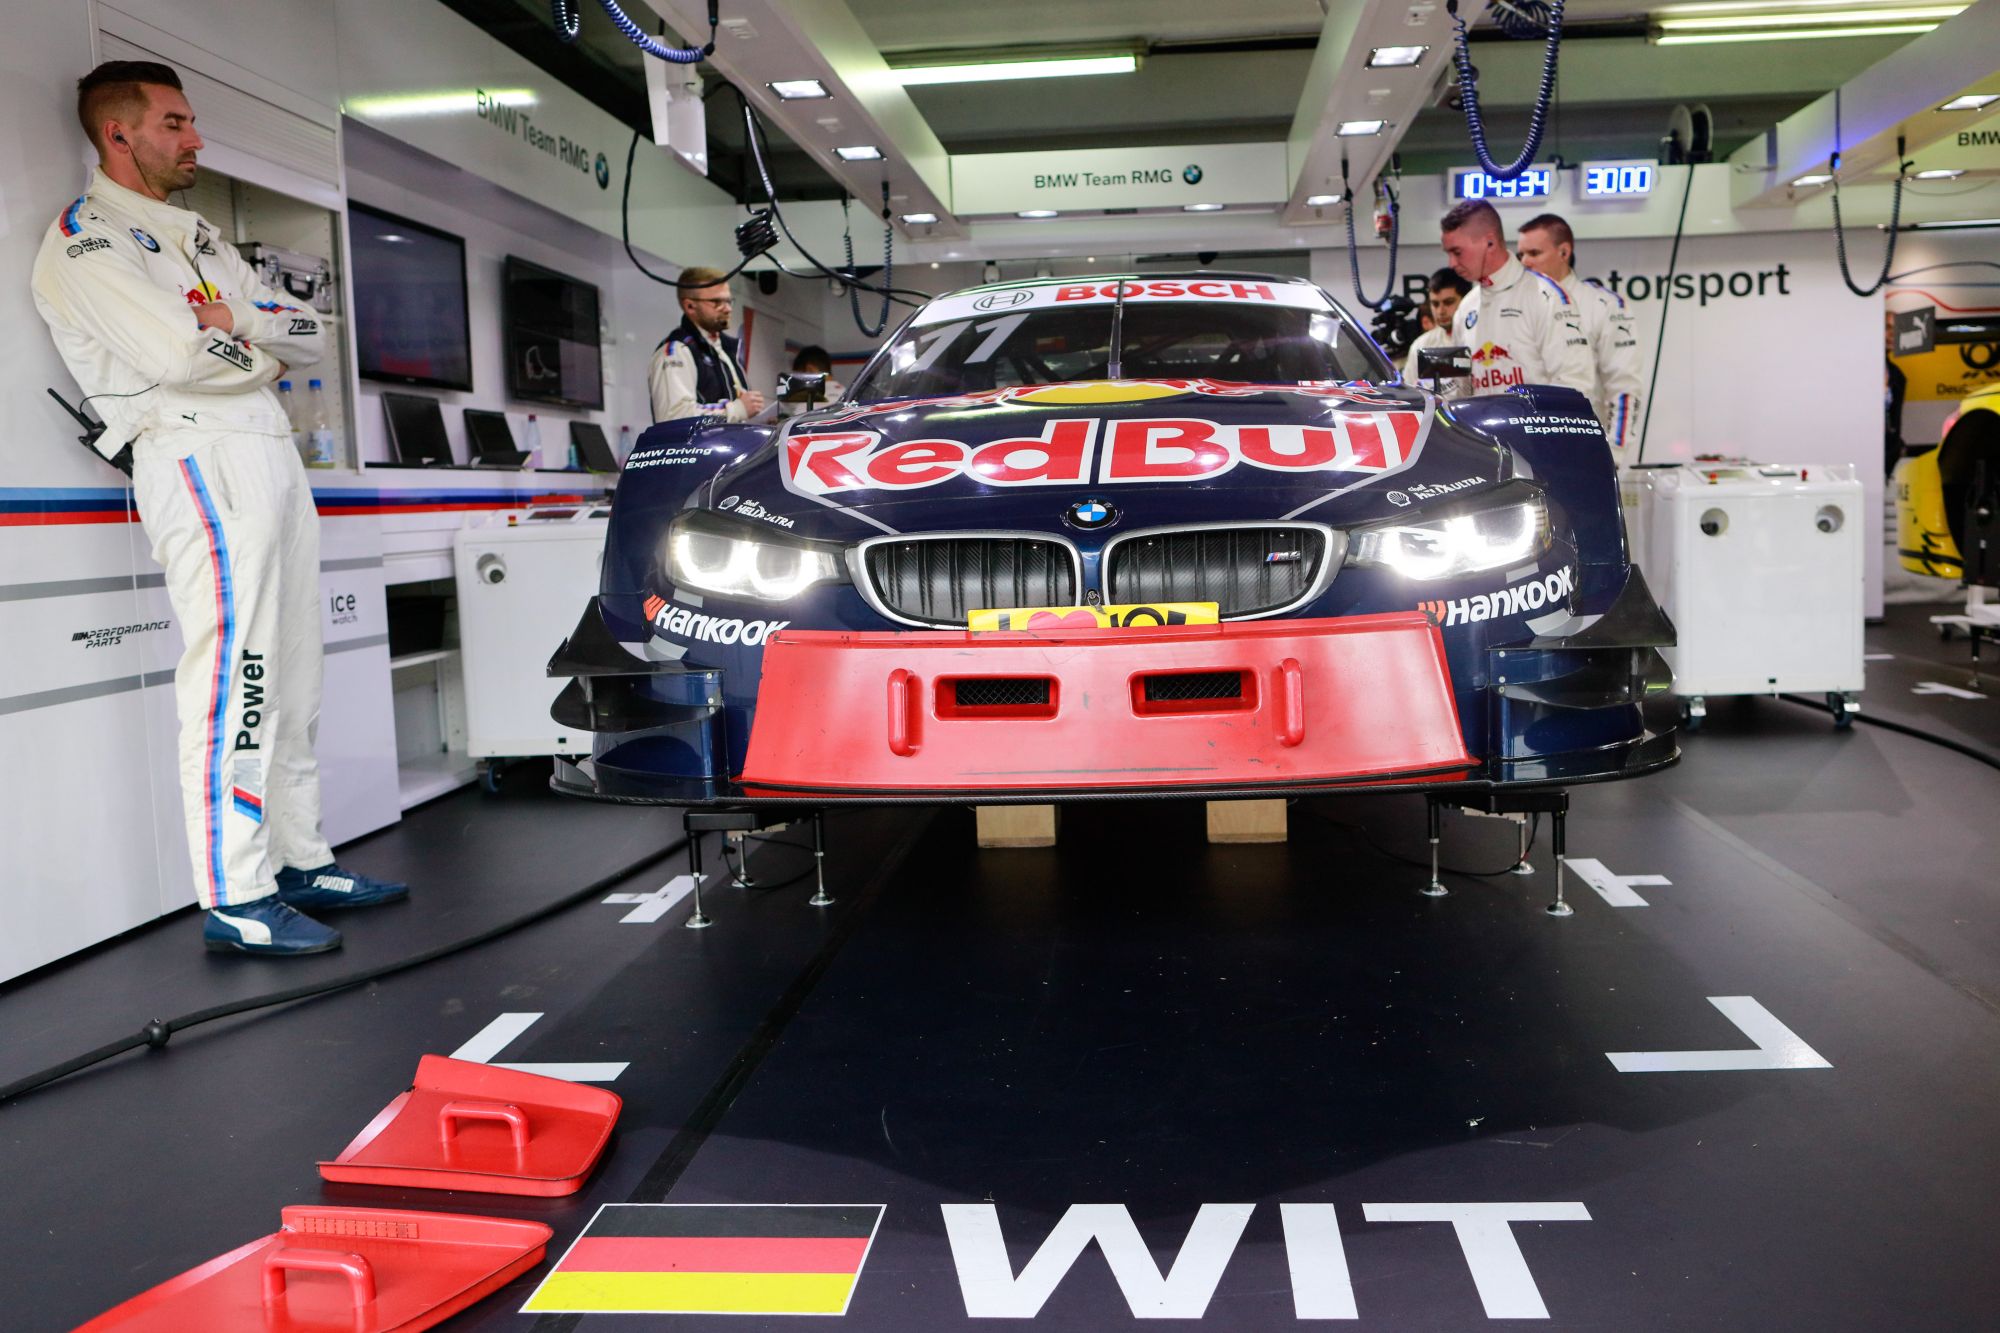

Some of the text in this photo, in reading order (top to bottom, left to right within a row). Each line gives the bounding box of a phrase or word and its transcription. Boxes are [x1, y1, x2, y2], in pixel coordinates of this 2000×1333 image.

[476, 88, 590, 174] BMW Team RMG
[1034, 168, 1173, 188] BMW Team RMG
[1587, 166, 1650, 194] 3000
[1055, 282, 1276, 302] BOSCH
[899, 312, 1031, 373] 11
[1491, 367, 1524, 386] Bull
[1508, 416, 1599, 428] BMW Driving
[1524, 425, 1602, 436] Experience
[628, 447, 713, 461] BMW Driving
[786, 411, 1427, 490] Red Bull
[625, 456, 697, 470] Experience
[1449, 476, 1487, 492] ULTRA
[331, 588, 356, 613] ice
[87, 620, 171, 639] PERFORMANCE
[86, 635, 122, 648] PARTS
[235, 649, 264, 751] Power
[312, 875, 354, 893] PUMA
[940, 1202, 1592, 1319] WIT
